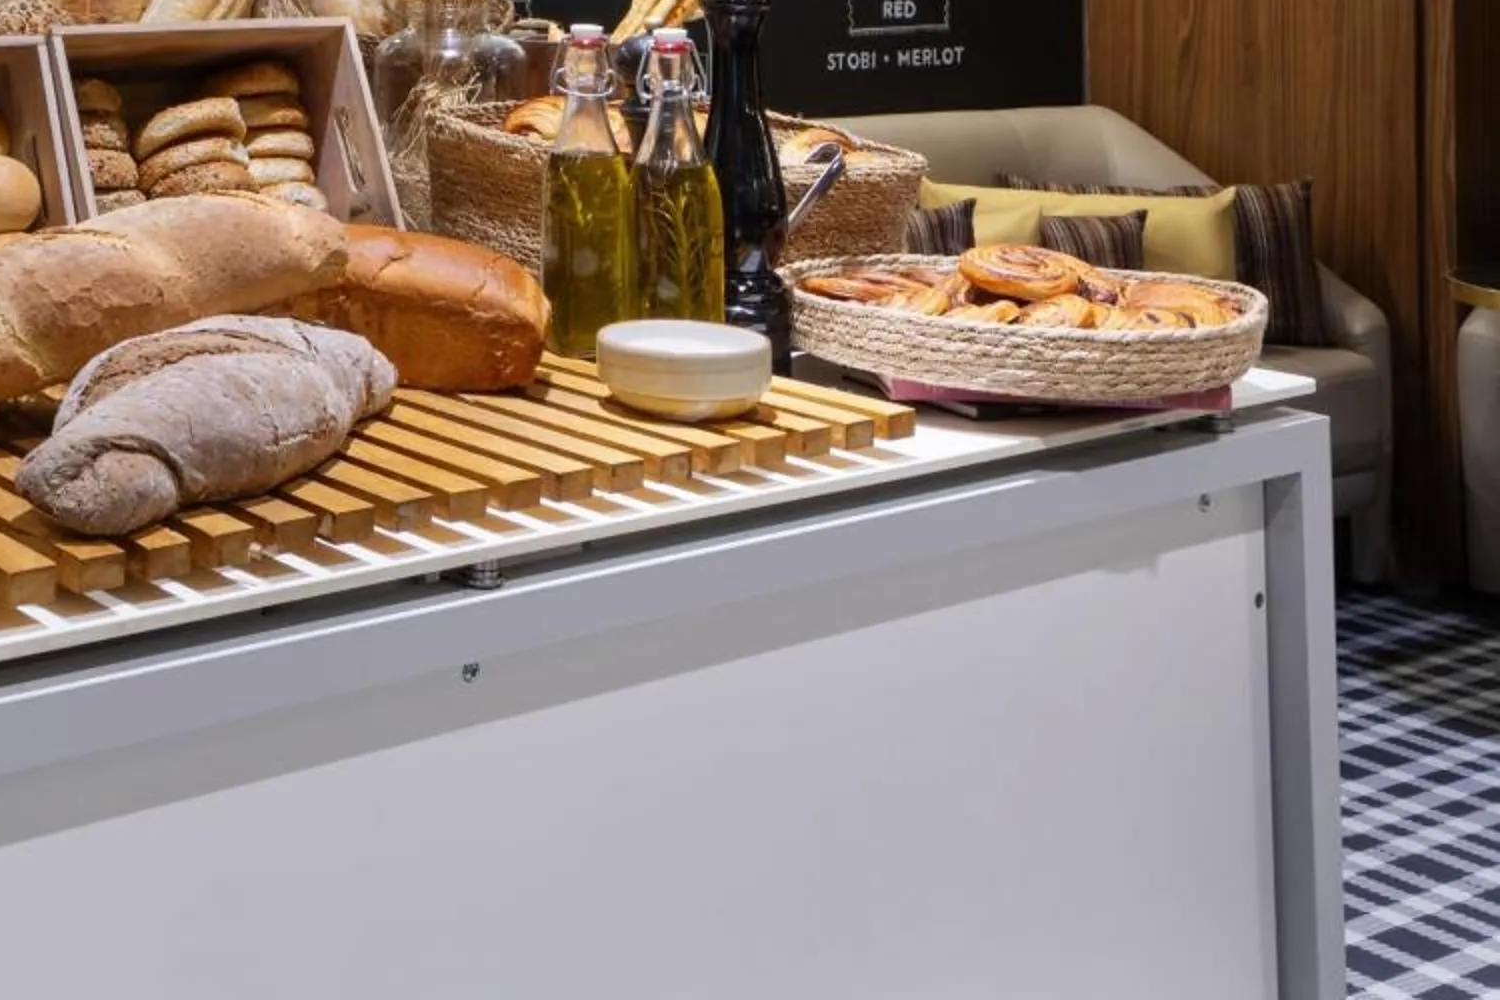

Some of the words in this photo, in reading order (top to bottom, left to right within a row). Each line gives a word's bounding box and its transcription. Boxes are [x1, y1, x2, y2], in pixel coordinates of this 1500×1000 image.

[882, 0, 917, 20] RED
[826, 51, 877, 72] STOBI
[897, 45, 966, 68] MERLOT
